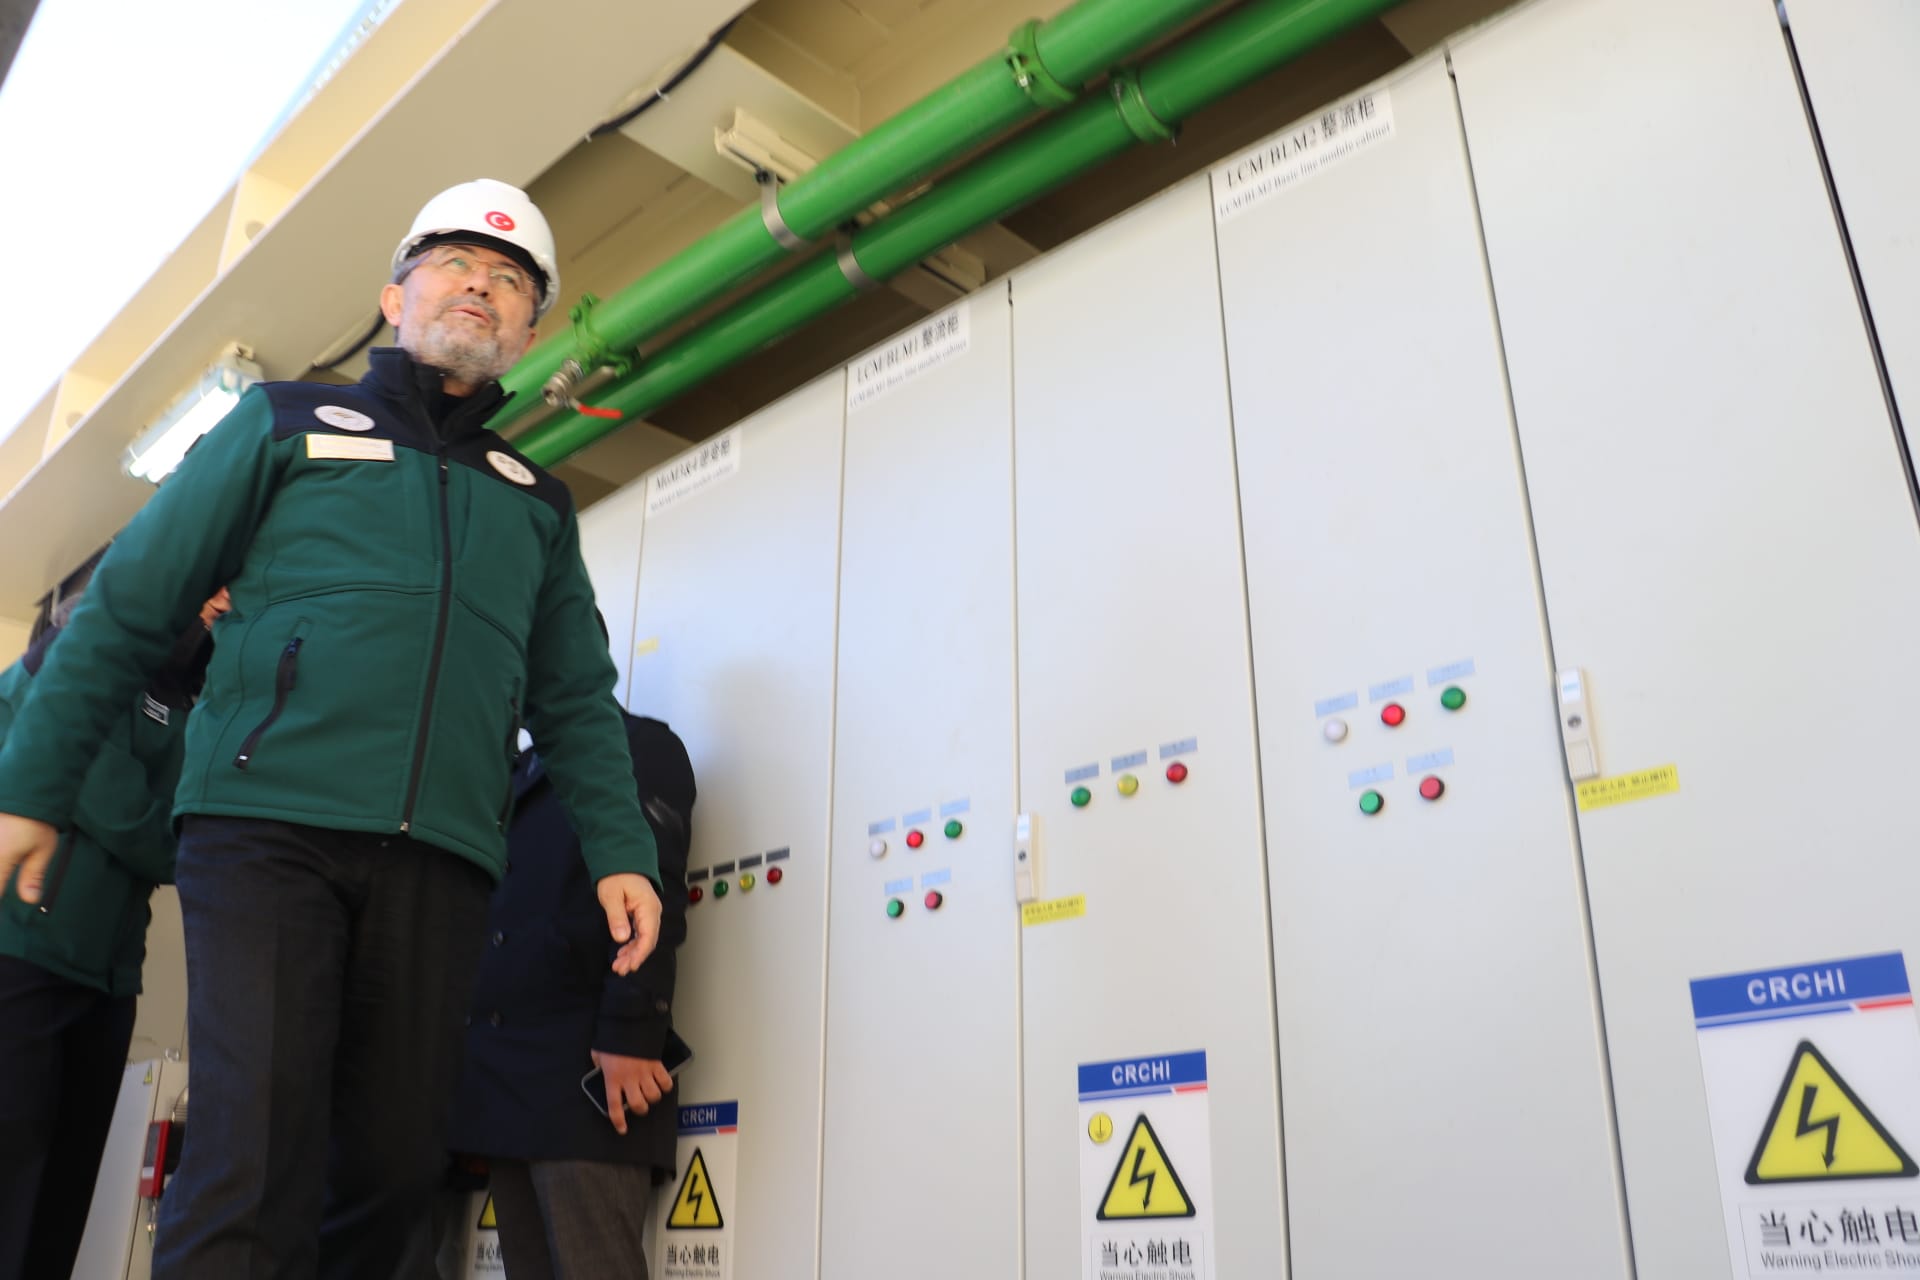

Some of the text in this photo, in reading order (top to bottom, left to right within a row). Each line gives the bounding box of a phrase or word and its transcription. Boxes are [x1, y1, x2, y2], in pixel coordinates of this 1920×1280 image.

[1226, 124, 1318, 189] LCM/BLM2
[1747, 967, 1847, 1005] CRCHI
[1111, 1059, 1171, 1086] CRCHI
[682, 1107, 717, 1126] CRCHI
[1759, 1206, 1920, 1247] 当心触电
[667, 1243, 719, 1265] 当心触电
[1102, 1237, 1192, 1268] 当心触电
[1760, 1251, 1822, 1271] Warning
[1823, 1250, 1881, 1270] Electric
